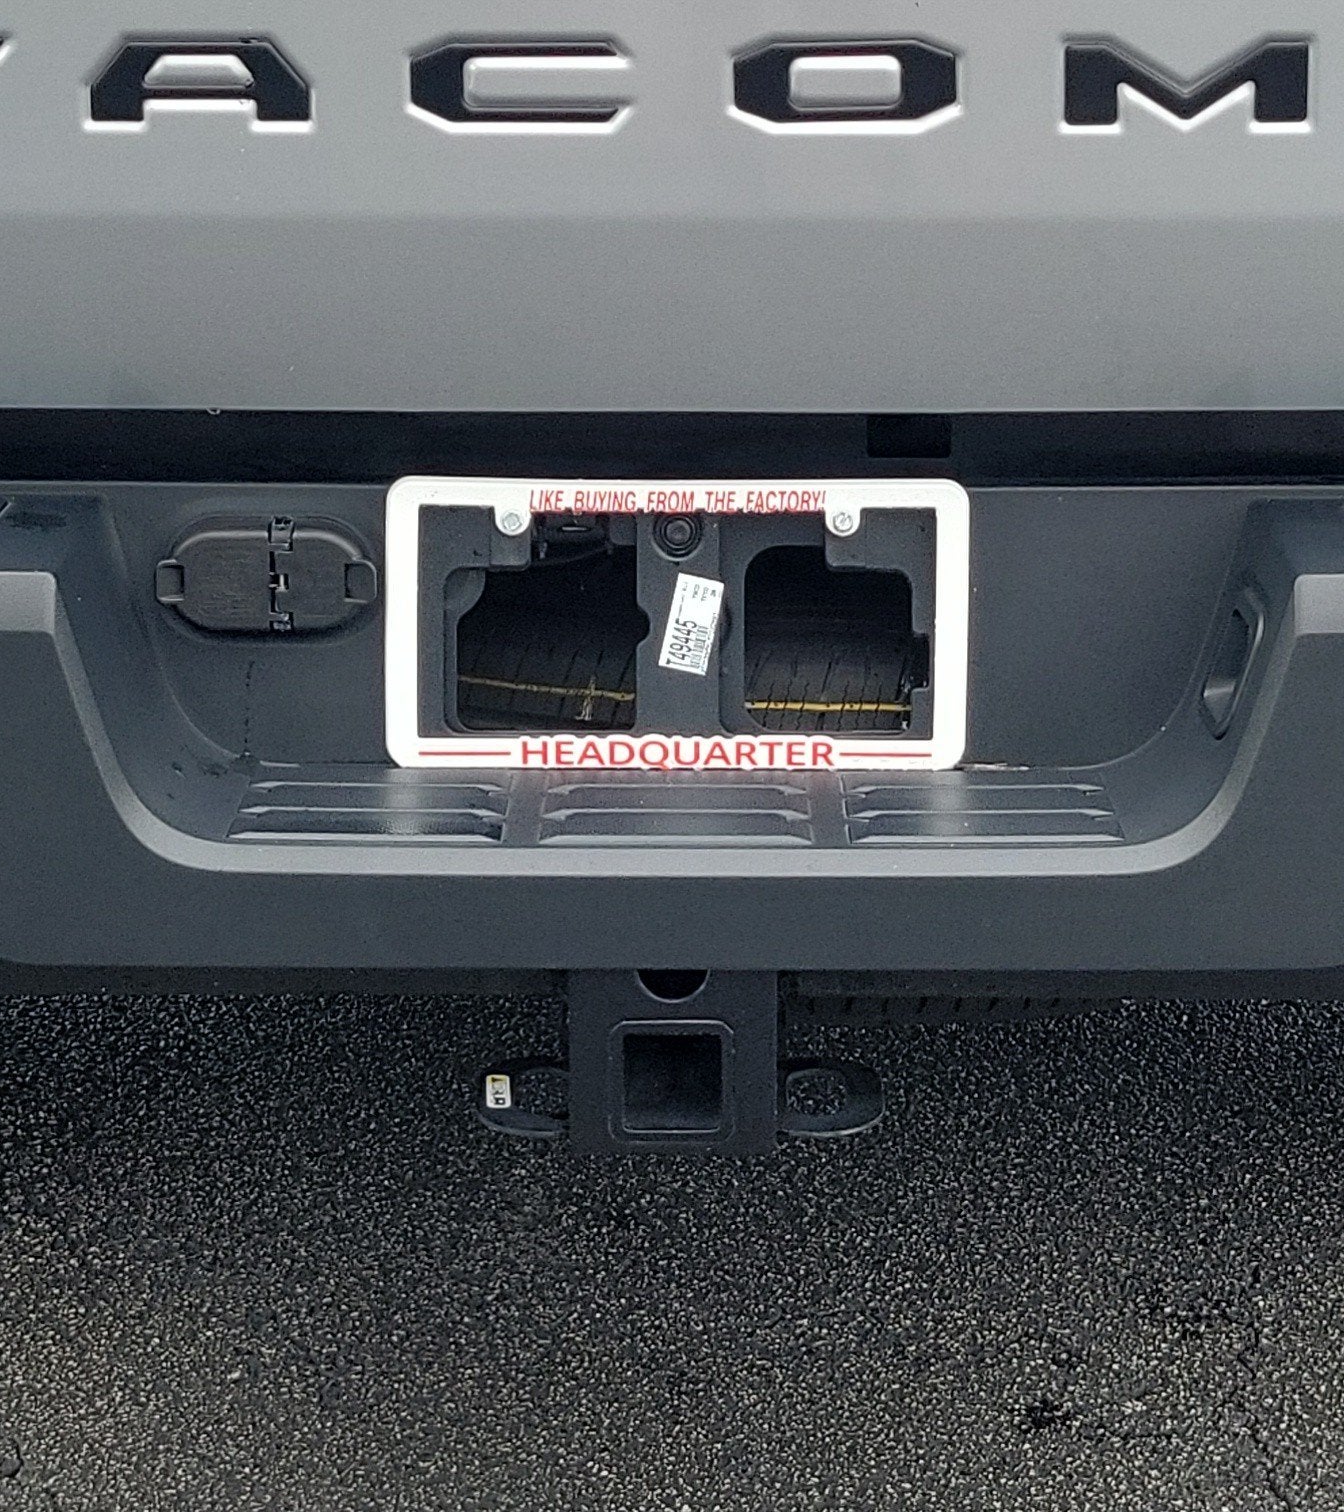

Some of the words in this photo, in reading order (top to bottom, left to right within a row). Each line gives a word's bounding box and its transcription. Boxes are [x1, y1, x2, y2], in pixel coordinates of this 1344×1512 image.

[529, 489, 564, 511] LIKE
[574, 489, 637, 511] BUYING
[646, 490, 695, 511] FROM
[705, 490, 736, 511] THE
[746, 490, 827, 511] FACTORY!
[665, 620, 699, 668] T49445
[522, 740, 835, 770] HEADQUARTER
